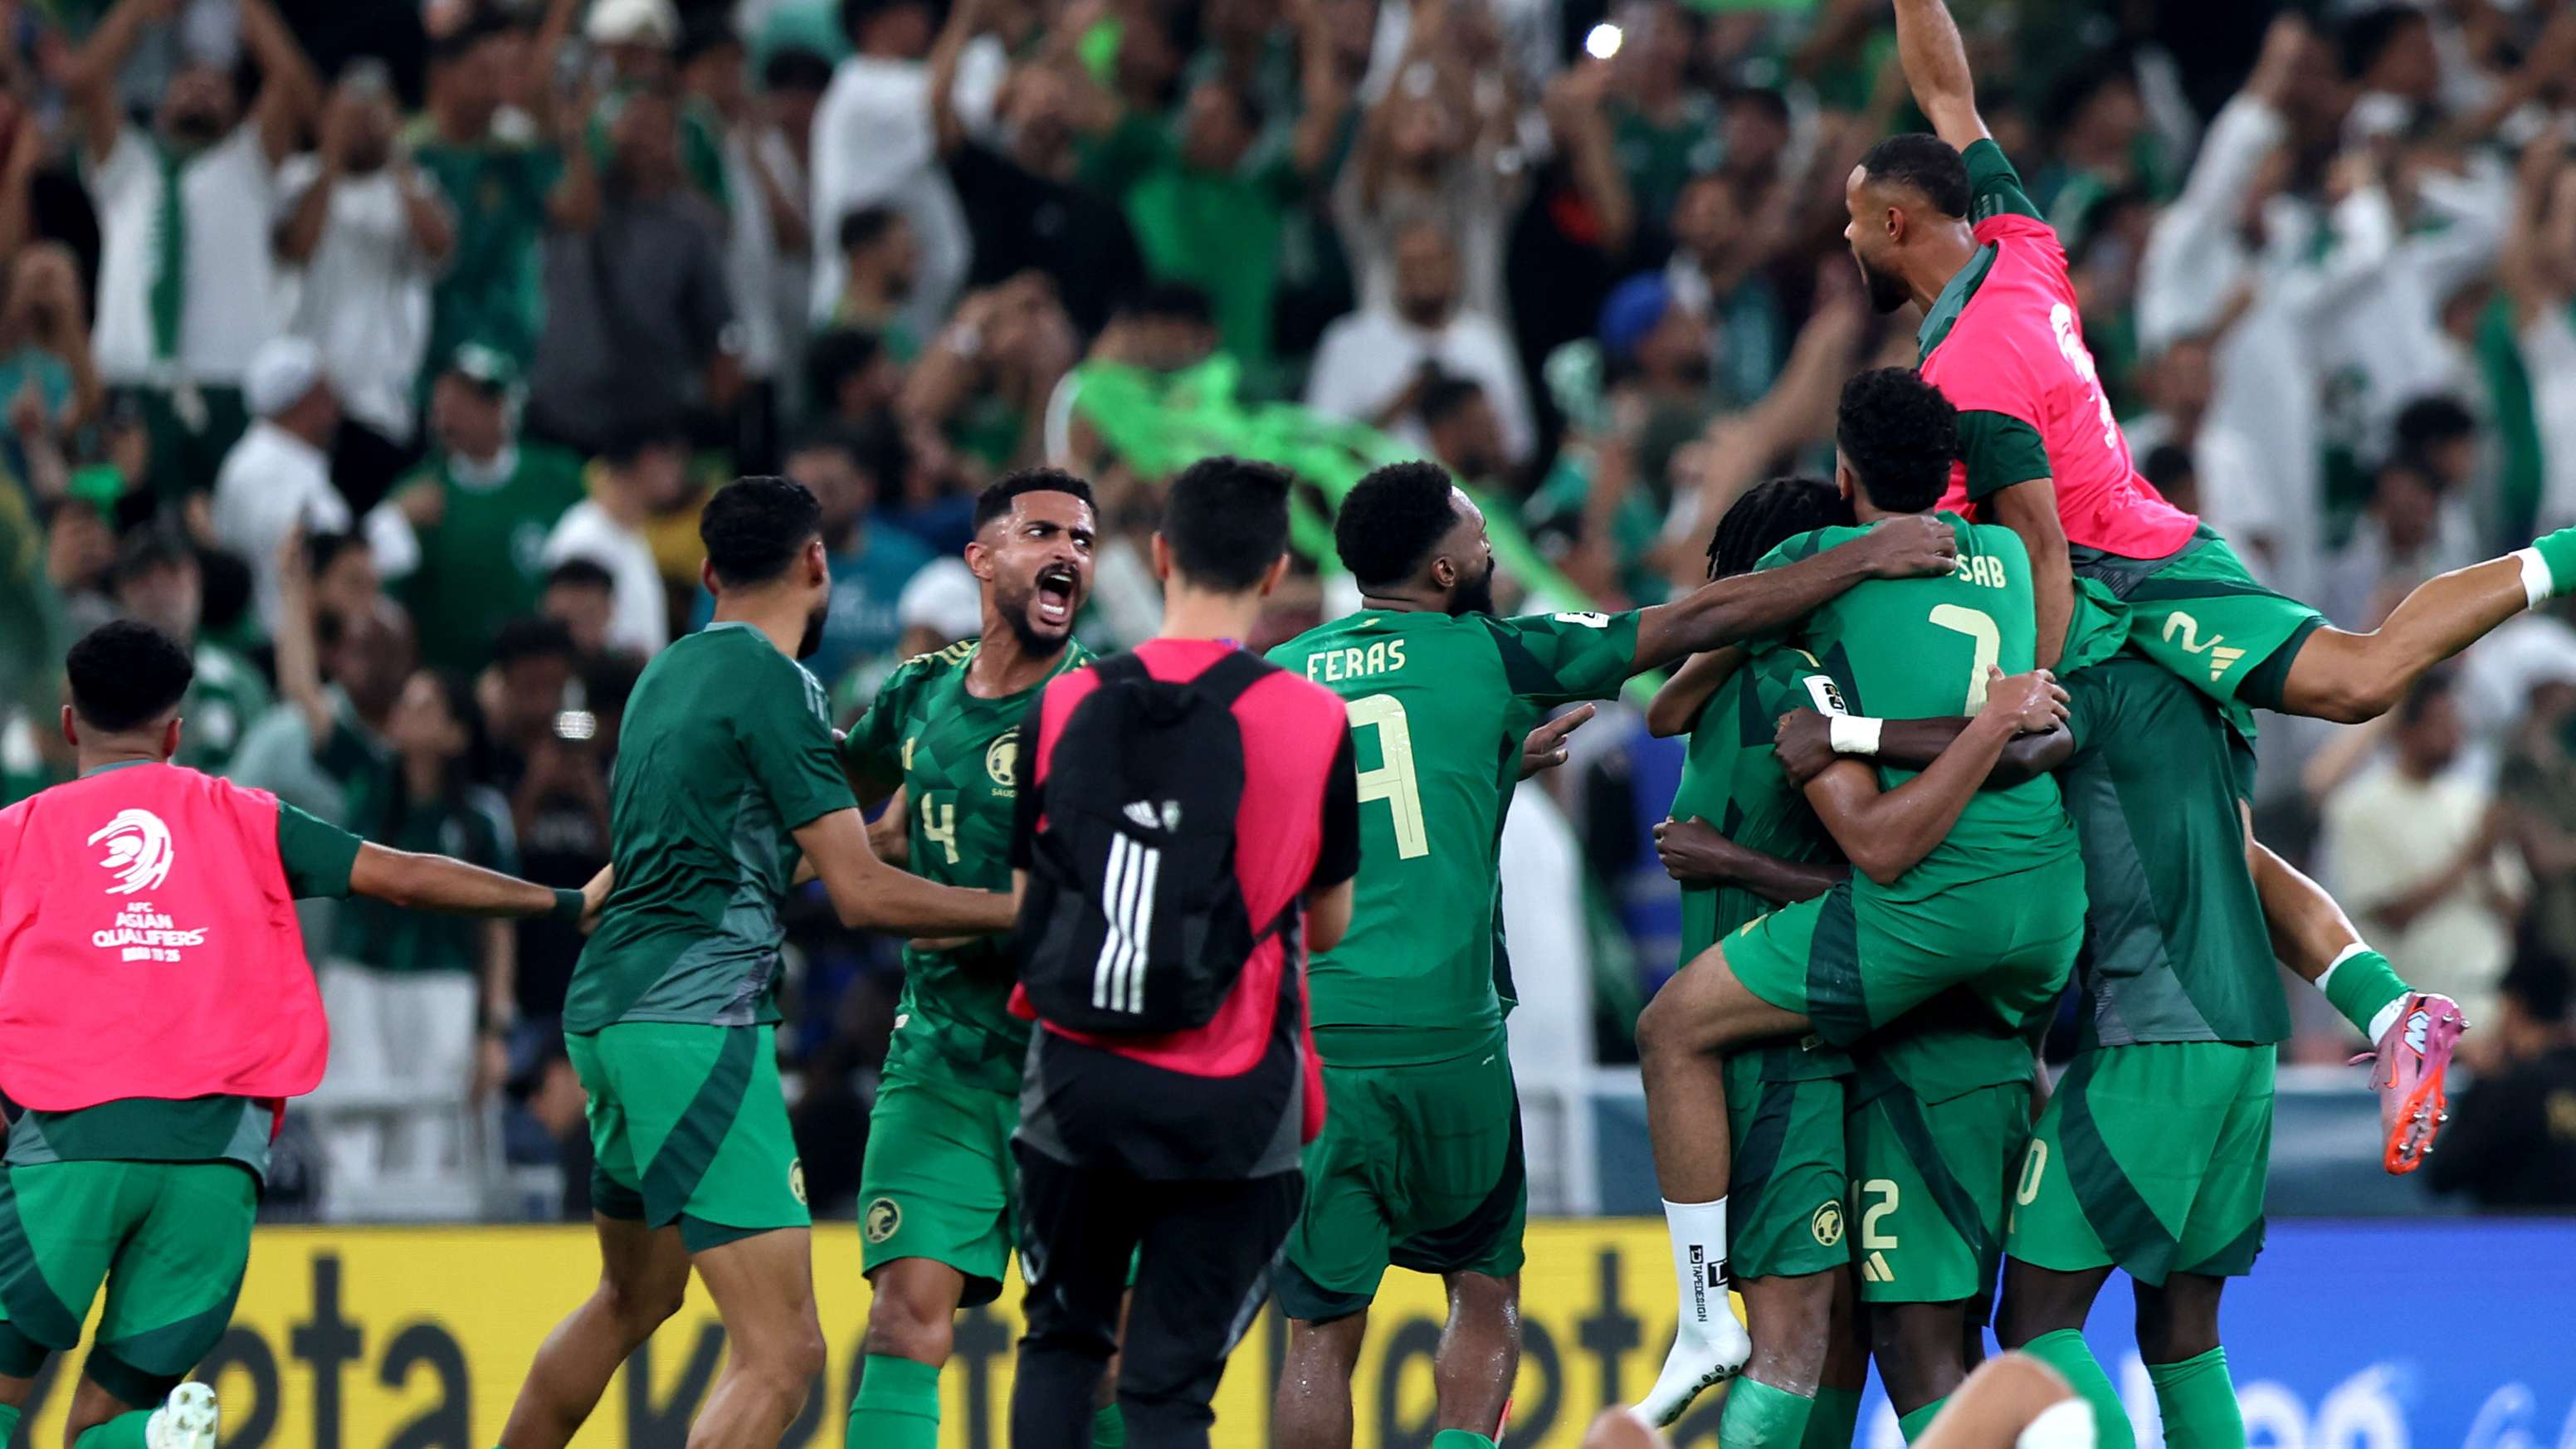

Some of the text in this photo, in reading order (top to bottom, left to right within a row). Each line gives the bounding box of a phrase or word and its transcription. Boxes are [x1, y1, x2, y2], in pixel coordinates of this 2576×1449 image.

[1946, 554, 2007, 588] SAB
[2163, 611, 2224, 654] 2
[1306, 638, 1407, 683] FERAS
[1929, 603, 2001, 717] 7
[921, 792, 960, 865] 4
[115, 911, 174, 929] ASIAN
[127, 901, 154, 913] AFC
[91, 927, 209, 948] QUALIFIERS
[1692, 1264, 1708, 1323] TAPEDESIGN
